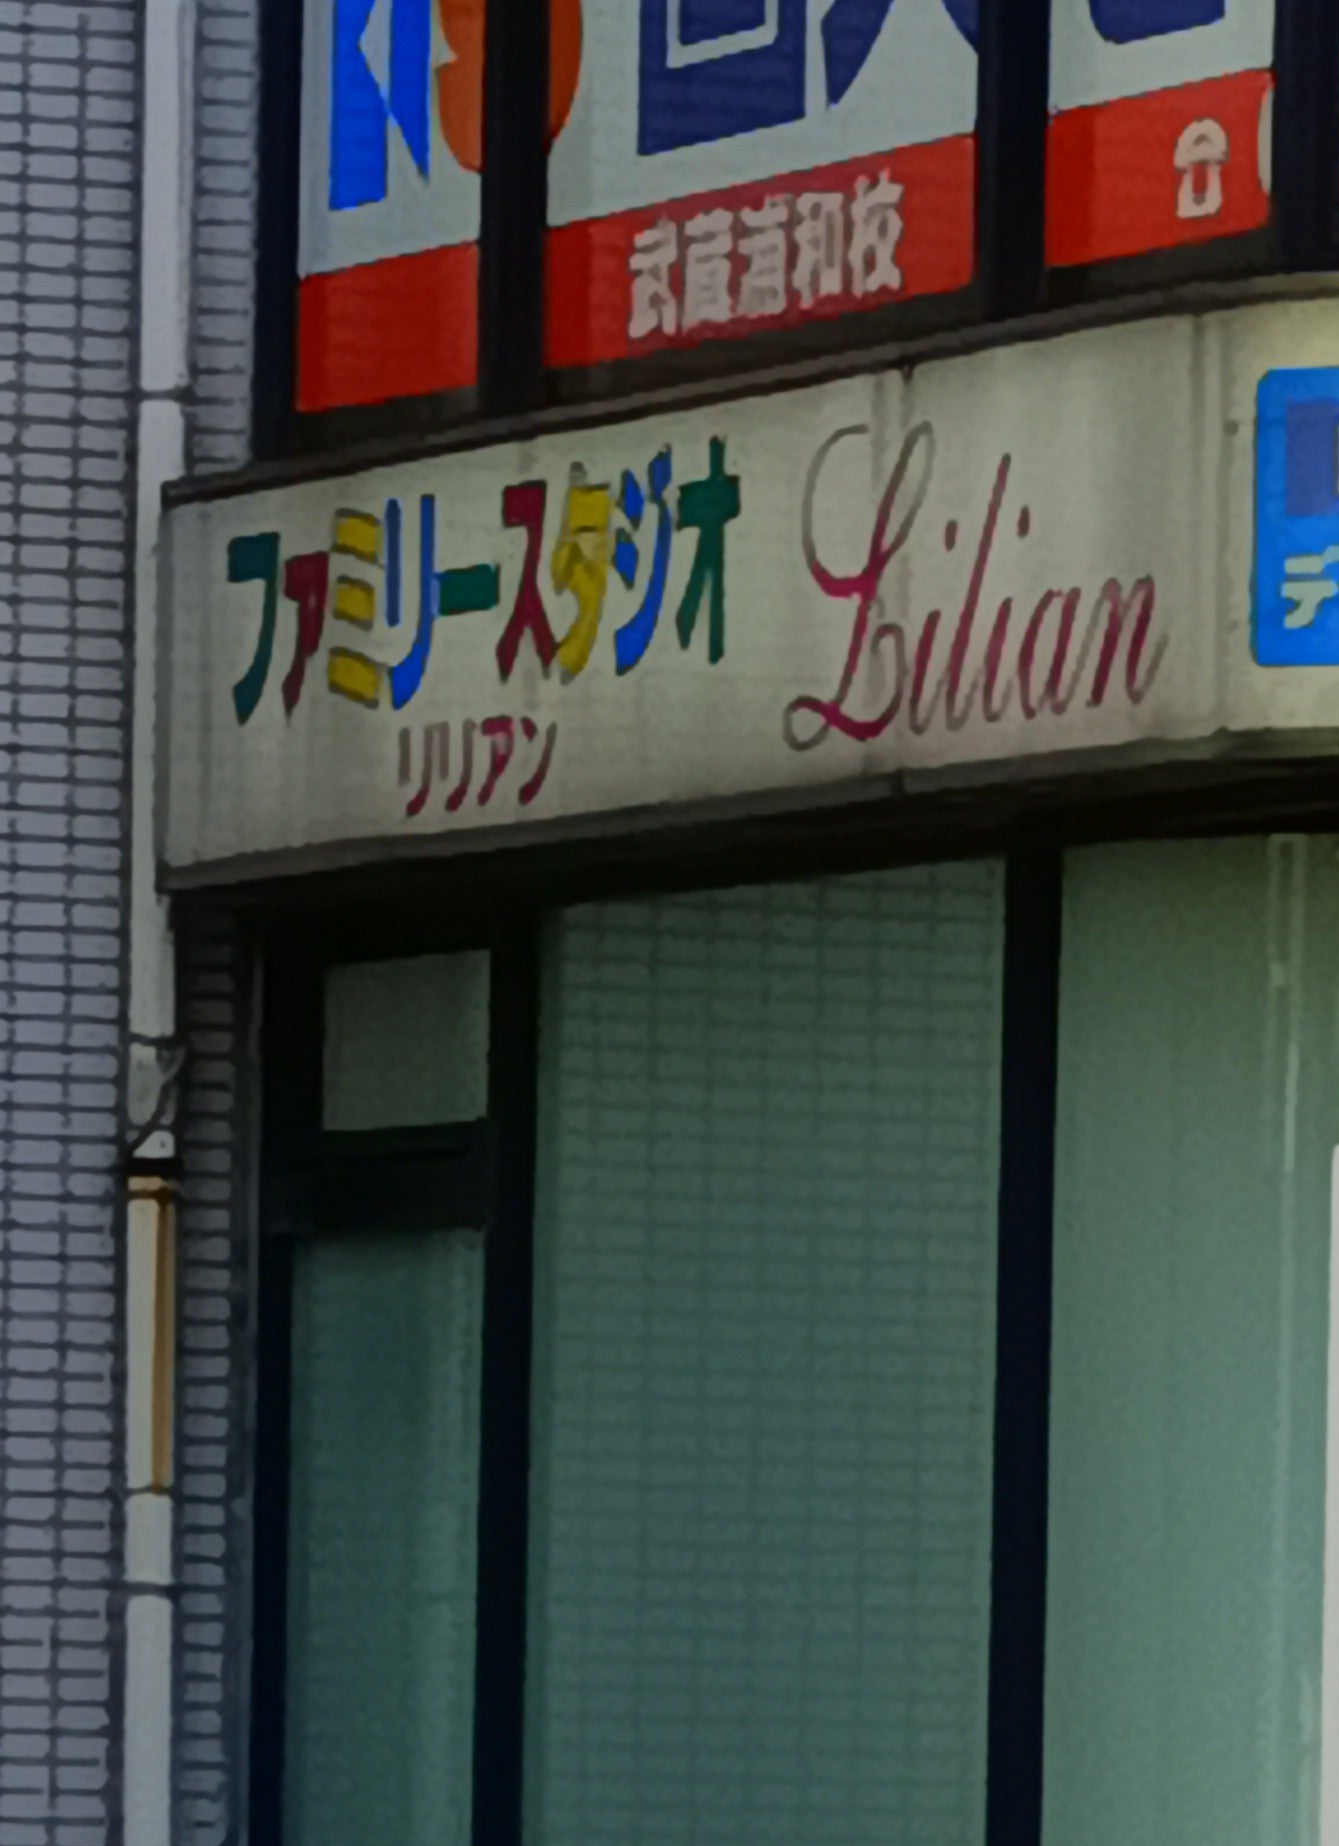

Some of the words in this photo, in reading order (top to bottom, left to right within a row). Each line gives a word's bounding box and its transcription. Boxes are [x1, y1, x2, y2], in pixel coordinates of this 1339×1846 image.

[227, 436, 741, 724] ファミリースタジオ
[783, 421, 1168, 751] Lilian
[400, 716, 557, 818] リリアン
